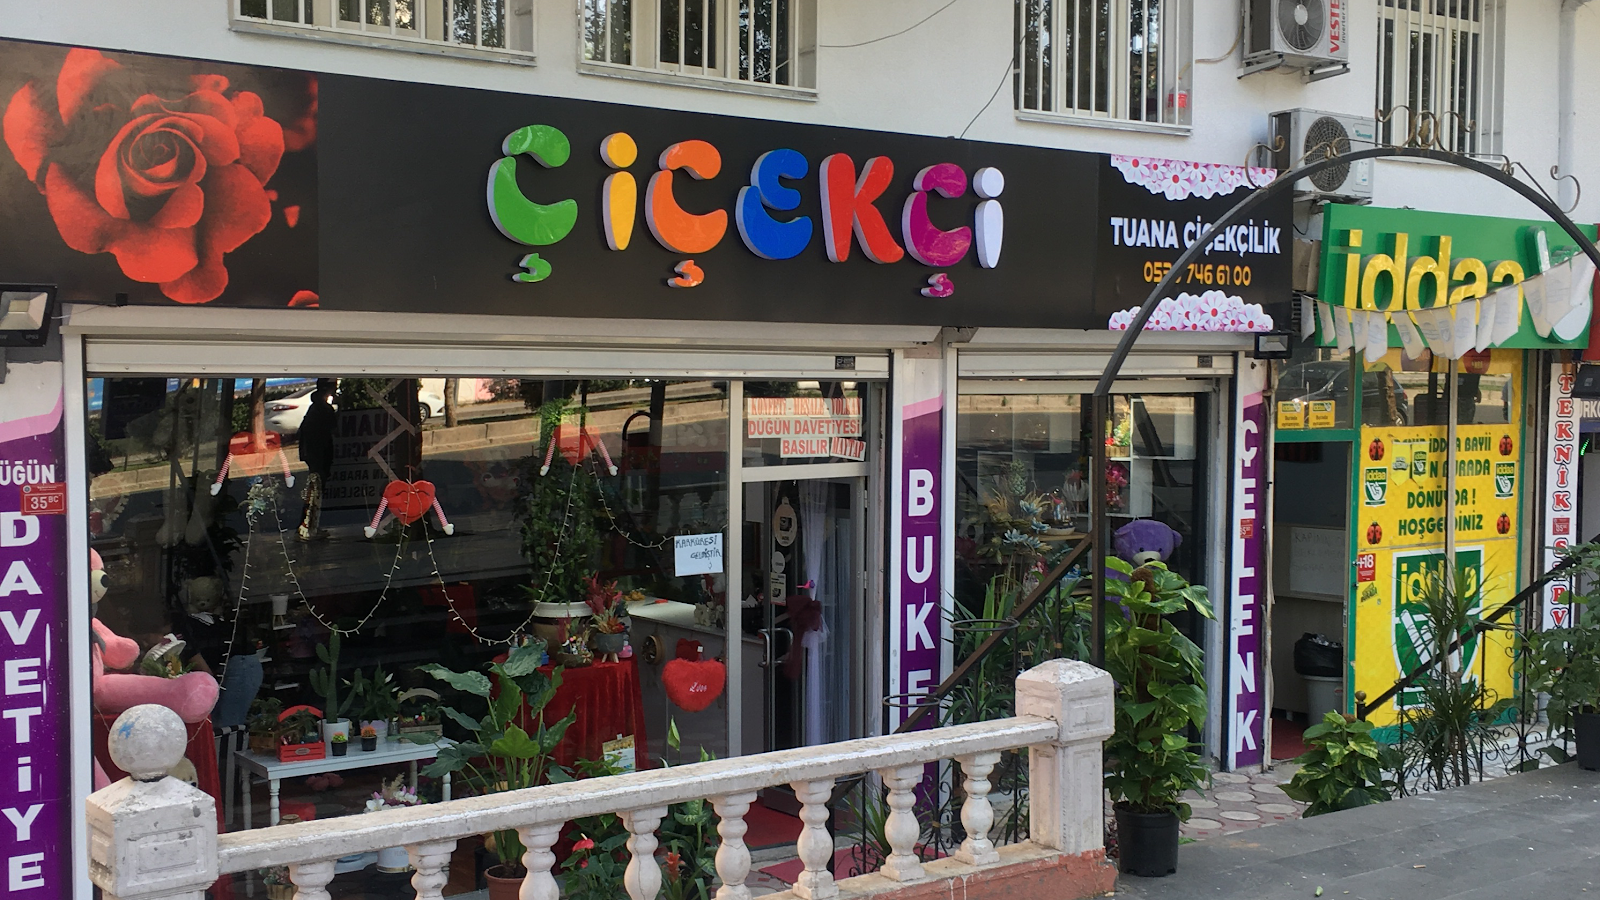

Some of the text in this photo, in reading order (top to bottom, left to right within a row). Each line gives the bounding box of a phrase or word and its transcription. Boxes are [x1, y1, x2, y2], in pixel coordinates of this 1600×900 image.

[487, 124, 1005, 298] ÇİÇEKÇİ
[1110, 216, 1179, 249] TUANA
[1186, 263, 1213, 286] 746
[1216, 264, 1231, 286] 61
[1233, 265, 1252, 286] 00
[1343, 229, 1525, 327] iddaa
[748, 417, 791, 436] DÜĞÜN
[782, 439, 828, 455] BASILIR
[1551, 372, 1576, 512] TEKNİK
[1356, 554, 1374, 569] +18
